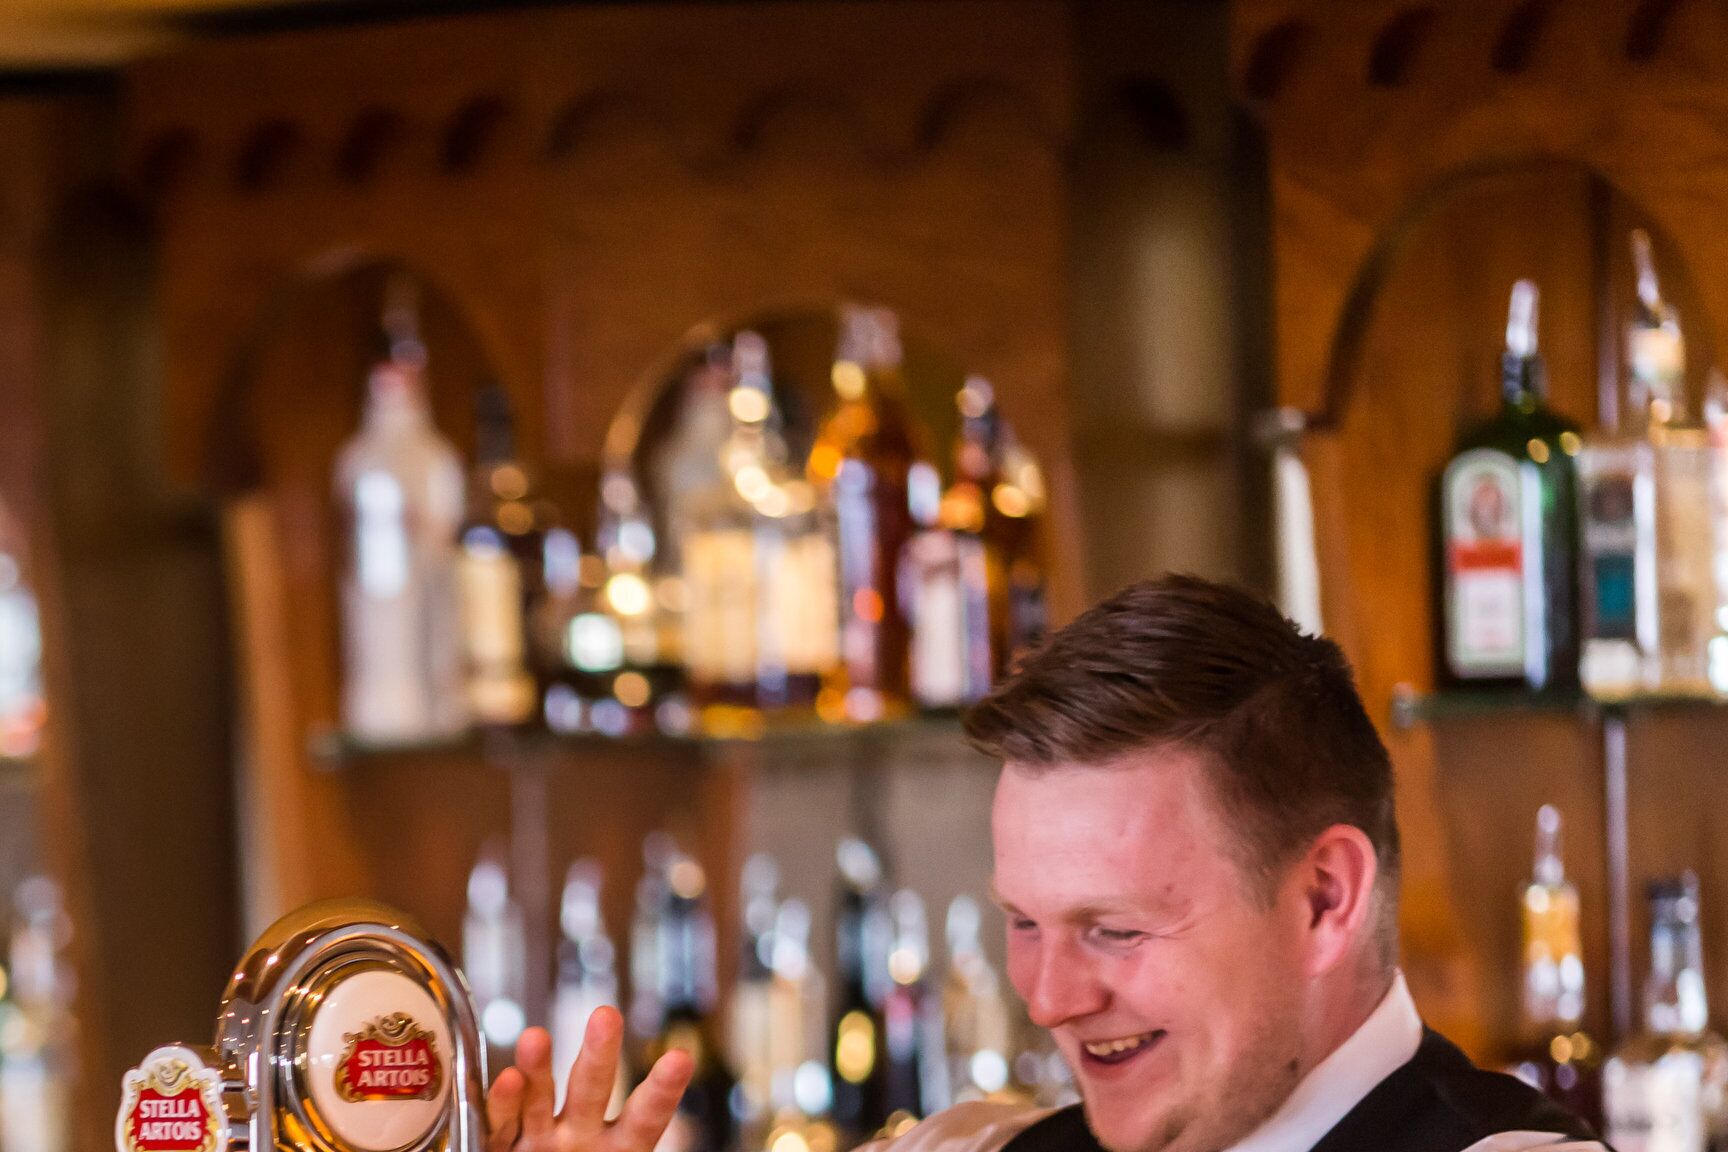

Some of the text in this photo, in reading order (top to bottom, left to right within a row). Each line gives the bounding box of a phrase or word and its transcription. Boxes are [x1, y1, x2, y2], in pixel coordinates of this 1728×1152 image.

[357, 1048, 429, 1067] STELLA
[356, 1068, 430, 1087] ARTOIS
[139, 1099, 201, 1118] STELLA
[138, 1121, 202, 1141] ARTOIS
